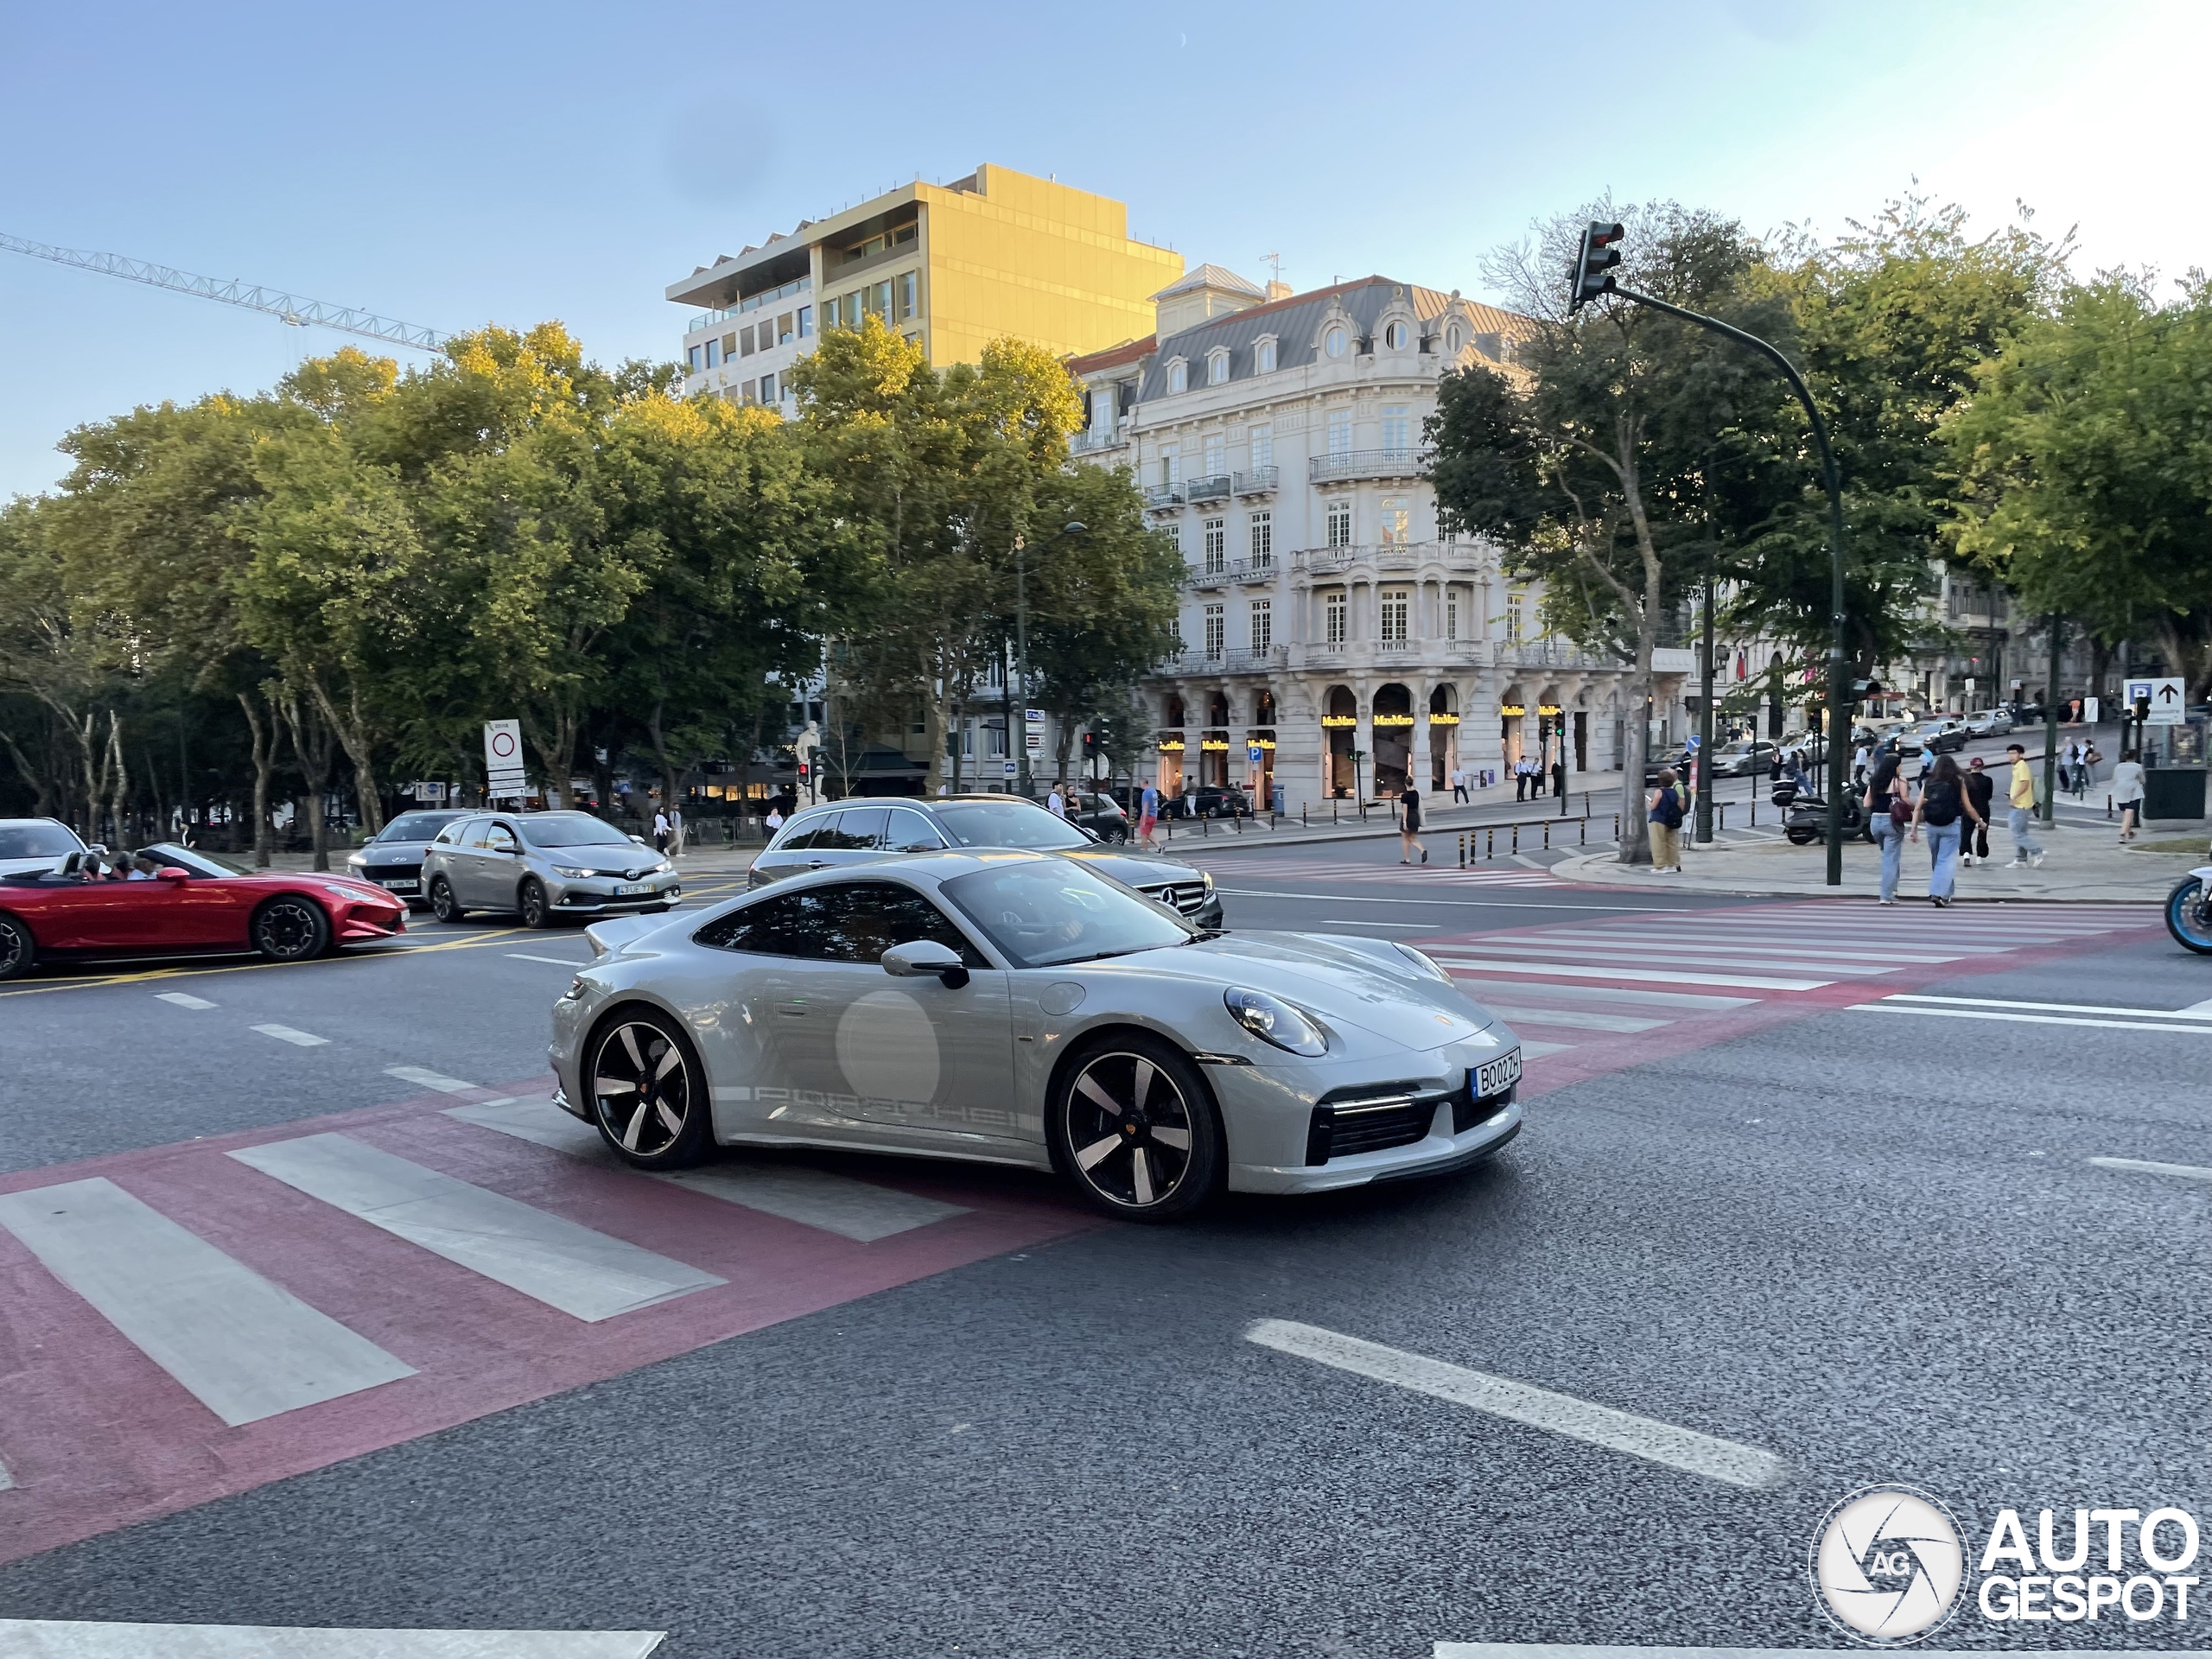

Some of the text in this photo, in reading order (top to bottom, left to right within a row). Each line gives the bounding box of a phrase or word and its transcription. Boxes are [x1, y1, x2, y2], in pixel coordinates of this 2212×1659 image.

[1322, 715, 1357, 727] MaxMara
[1373, 714, 1414, 726] MaxMara
[1429, 714, 1459, 725] MaxMara
[1202, 740, 1230, 751] MaxMara
[1251, 747, 1260, 760] P
